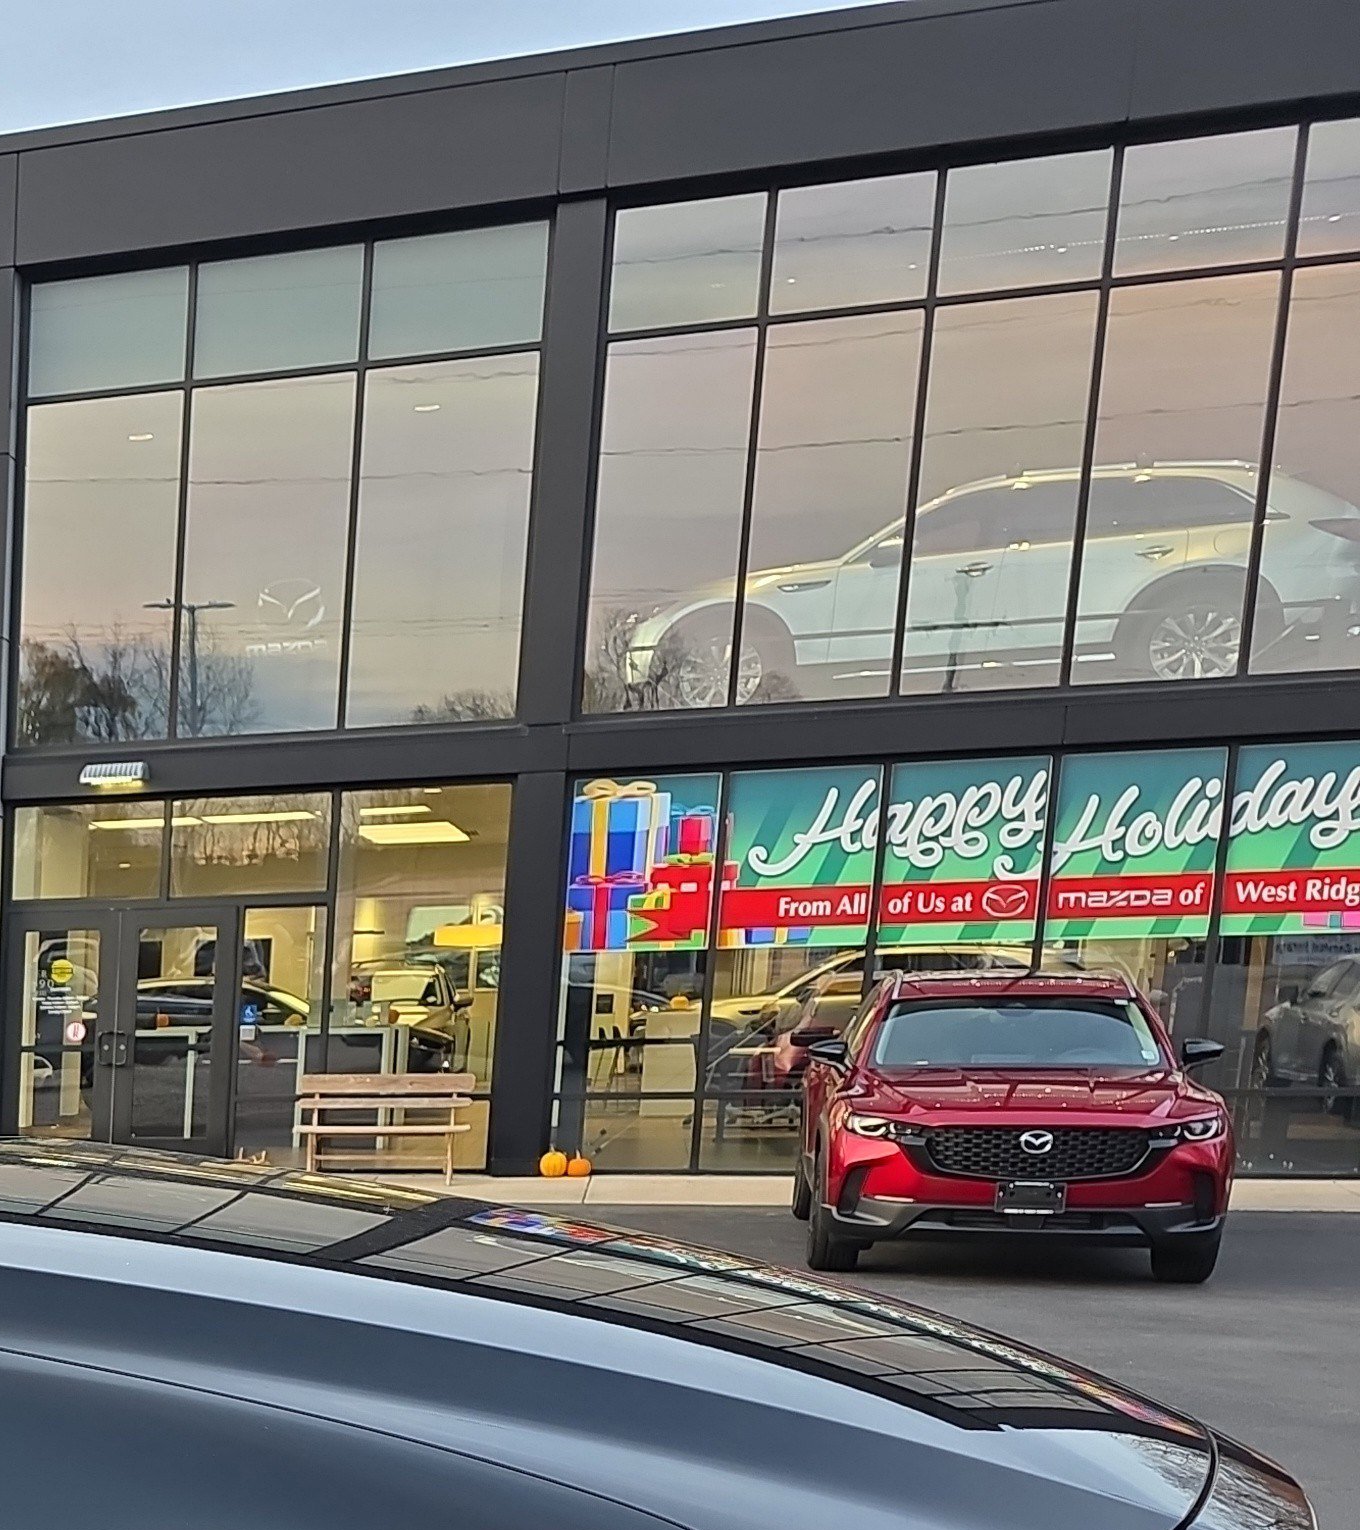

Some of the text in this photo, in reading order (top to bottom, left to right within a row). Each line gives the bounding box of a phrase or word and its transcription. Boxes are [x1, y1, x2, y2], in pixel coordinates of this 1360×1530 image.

[748, 759, 1360, 880] Happy Holiday
[778, 896, 831, 918] From
[837, 892, 868, 915] All
[888, 893, 912, 914] of
[917, 892, 946, 913] Us
[950, 891, 973, 912] at
[1057, 887, 1172, 909] mazda
[1179, 881, 1207, 906] of
[1235, 880, 1297, 903] West
